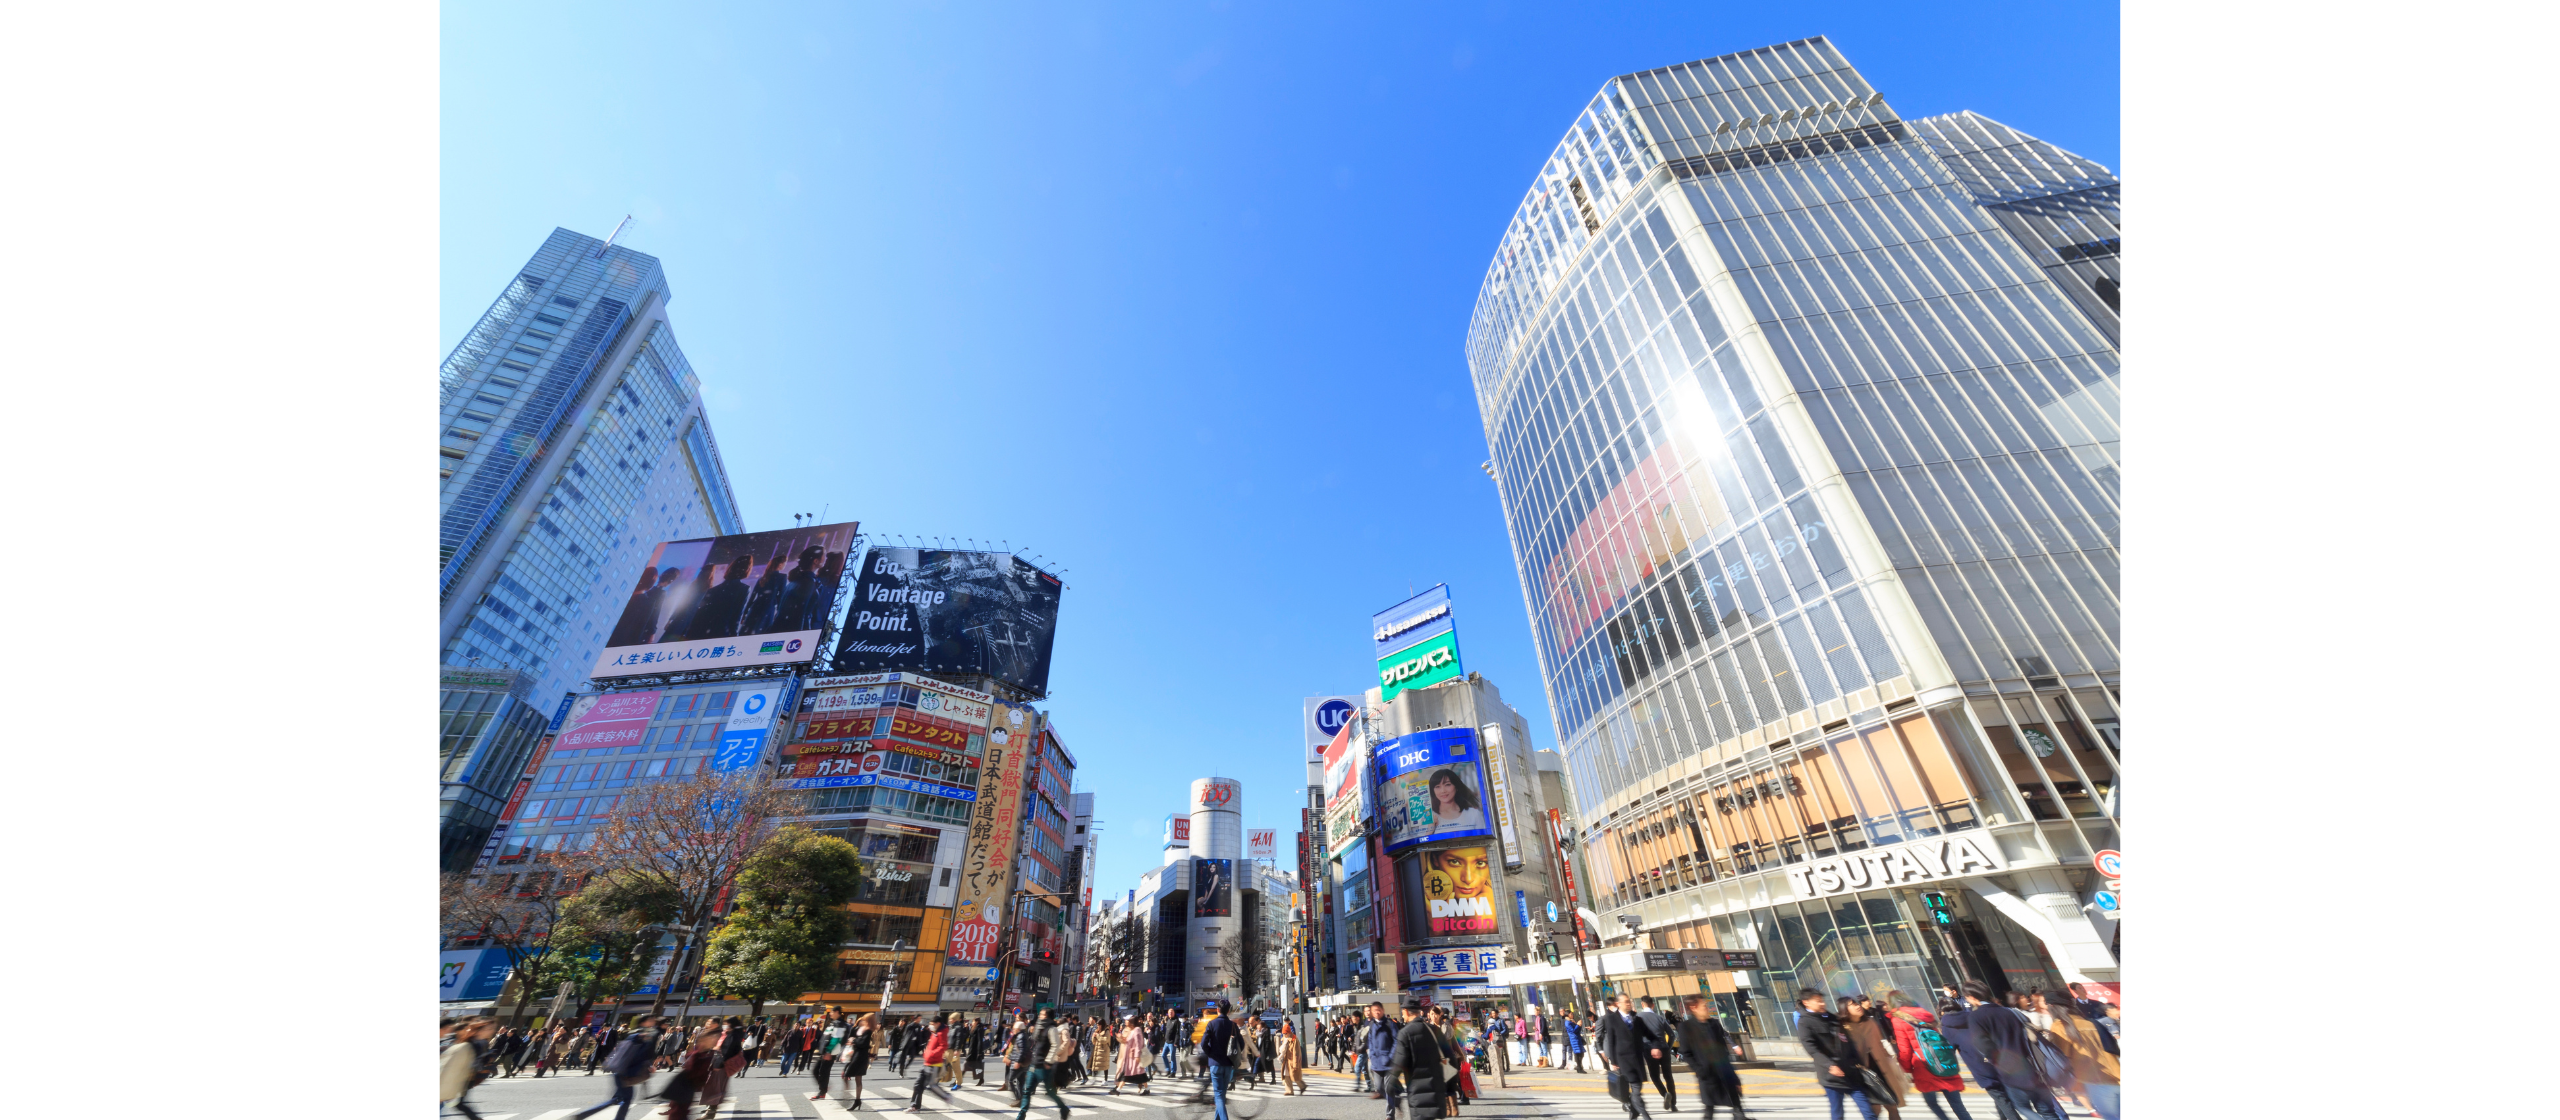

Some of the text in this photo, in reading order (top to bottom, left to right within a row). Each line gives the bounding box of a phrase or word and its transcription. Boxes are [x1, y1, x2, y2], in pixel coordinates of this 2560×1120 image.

[874, 557, 899, 575] Go
[868, 583, 945, 608] Vantage
[856, 611, 912, 632] Point.
[1373, 604, 1446, 640] Hisamitsu
[611, 645, 742, 666] 人生楽しい人の勝ち。
[846, 640, 917, 658] HondaJet
[1381, 646, 1453, 686] サロンパス
[814, 675, 883, 686] しゃぶしゃぶバイキング
[916, 677, 990, 701] しゃぶしゃぶバイキング
[611, 696, 655, 709] 品川スキン
[803, 697, 816, 705] 9F
[943, 699, 987, 719] しゃぶ葉
[608, 706, 647, 717] クリニック
[733, 715, 766, 725] eyecity
[569, 728, 639, 745] 品川美容外科
[809, 720, 872, 736] プライス
[892, 716, 965, 745] コンタクト
[840, 741, 873, 754] ガスト
[816, 759, 858, 776] ガスト
[939, 752, 973, 767] ガスト
[1399, 749, 1430, 768] DHC
[780, 764, 796, 773] 7F
[799, 777, 858, 788] 英会話イーオン
[882, 777, 905, 787] AEON
[911, 781, 975, 799] 英会話イーオン
[1198, 787, 1232, 806] 109
[987, 730, 1027, 888] 打首獄門同好会が
[1496, 789, 1509, 827] neon
[967, 749, 1002, 896] 日本武道館だって。
[1251, 832, 1273, 847] H&M
[876, 868, 913, 882] Ushi8
[1791, 838, 1993, 896] TSUTAYA
[1430, 897, 1492, 918] DMM
[1433, 916, 1494, 932] Bitcoin
[952, 923, 998, 944] 2018
[955, 941, 991, 962] 3.11
[1411, 952, 1497, 976] 大盛堂書店
